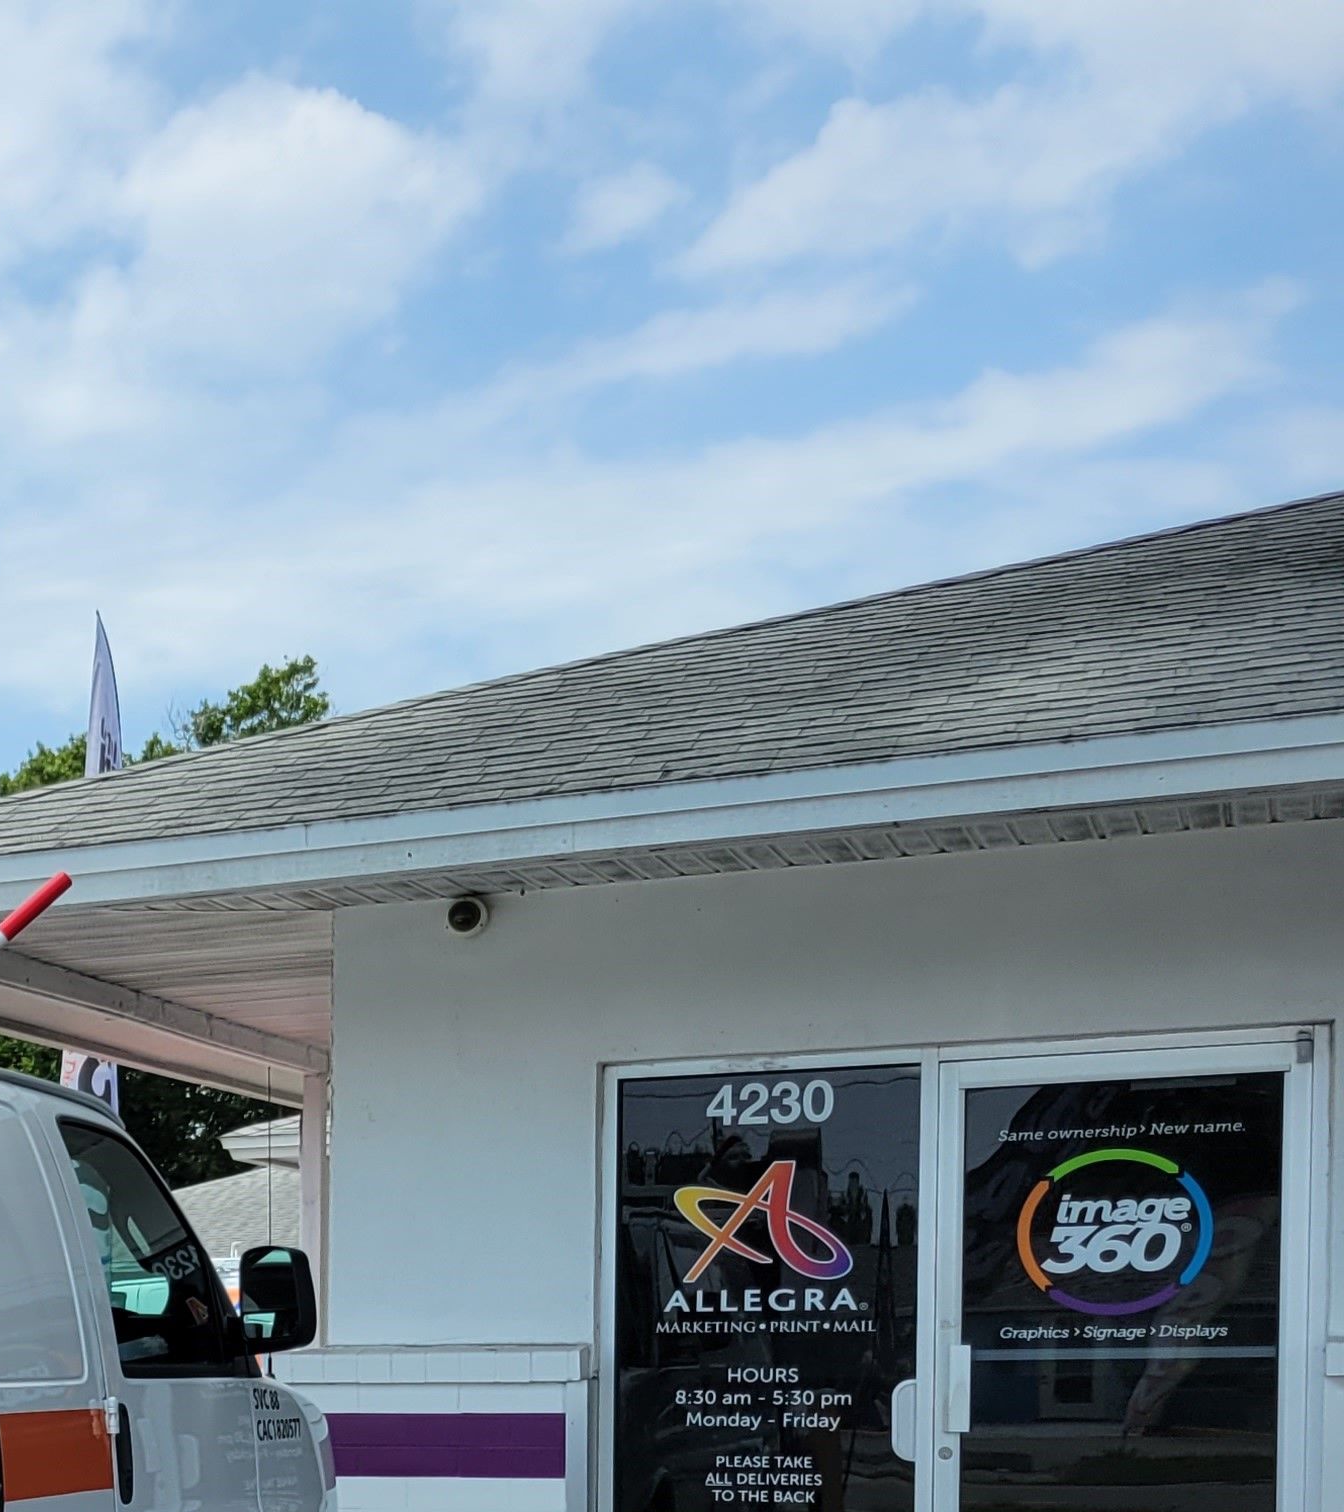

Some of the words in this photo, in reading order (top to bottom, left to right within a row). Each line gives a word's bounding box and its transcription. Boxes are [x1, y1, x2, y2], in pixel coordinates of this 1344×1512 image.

[706, 1080, 834, 1127] 4230
[998, 1129, 1044, 1143] Same
[1048, 1124, 1137, 1141] ownership
[1150, 1122, 1189, 1136] New
[1193, 1121, 1246, 1134] name.
[1056, 1194, 1191, 1225] image
[1040, 1222, 1182, 1274] 360
[663, 1287, 858, 1313] ALLEGRA
[769, 1320, 821, 1333] PRINT
[833, 1319, 877, 1333] MAIL
[999, 1325, 1070, 1342] Graphics
[1082, 1325, 1146, 1342] Signage
[1158, 1324, 1228, 1341] Displays
[727, 1367, 799, 1383] HOURS
[675, 1390, 716, 1405] 8:30
[722, 1393, 752, 1405] am
[772, 1390, 814, 1405] 5:30
[821, 1393, 853, 1409] pm
[686, 1412, 761, 1430] Monday
[783, 1413, 841, 1432] Friday
[716, 1456, 770, 1468] PLEASE
[774, 1456, 813, 1469] TAKE
[705, 1472, 732, 1486] ALL
[736, 1473, 822, 1487] DELIVERIES
[712, 1490, 734, 1502] TO
[738, 1490, 769, 1502] THE
[774, 1491, 815, 1504] BACK
